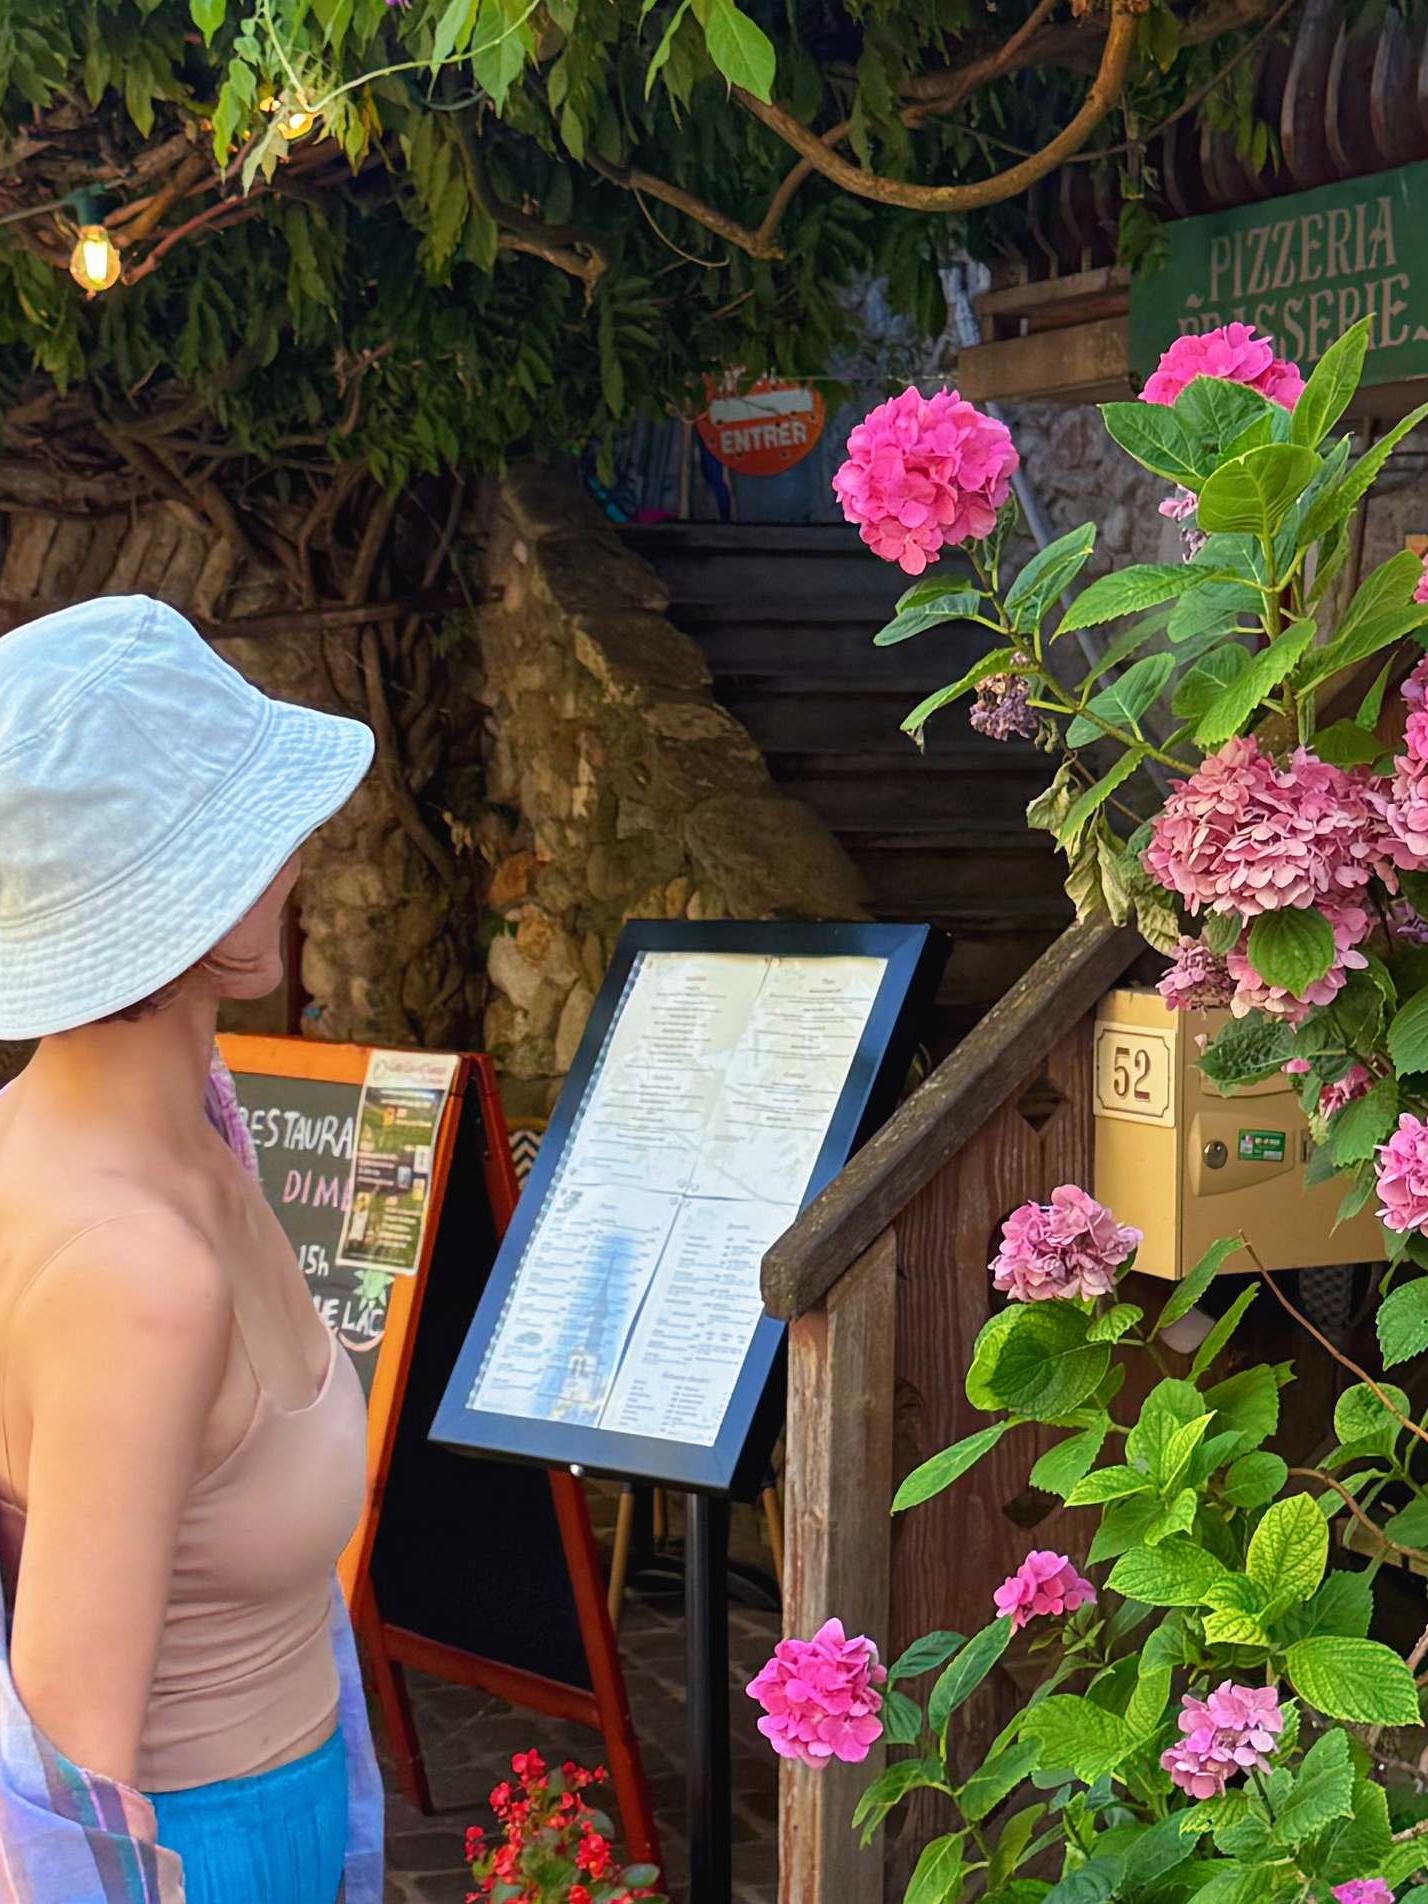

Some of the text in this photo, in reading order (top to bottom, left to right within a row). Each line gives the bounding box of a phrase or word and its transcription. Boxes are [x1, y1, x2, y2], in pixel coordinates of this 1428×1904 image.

[1209, 195, 1398, 304] PIZZERIA
[1176, 272, 1410, 364] SSERIE
[721, 420, 807, 456] ENTRER
[1113, 1046, 1152, 1103] 52
